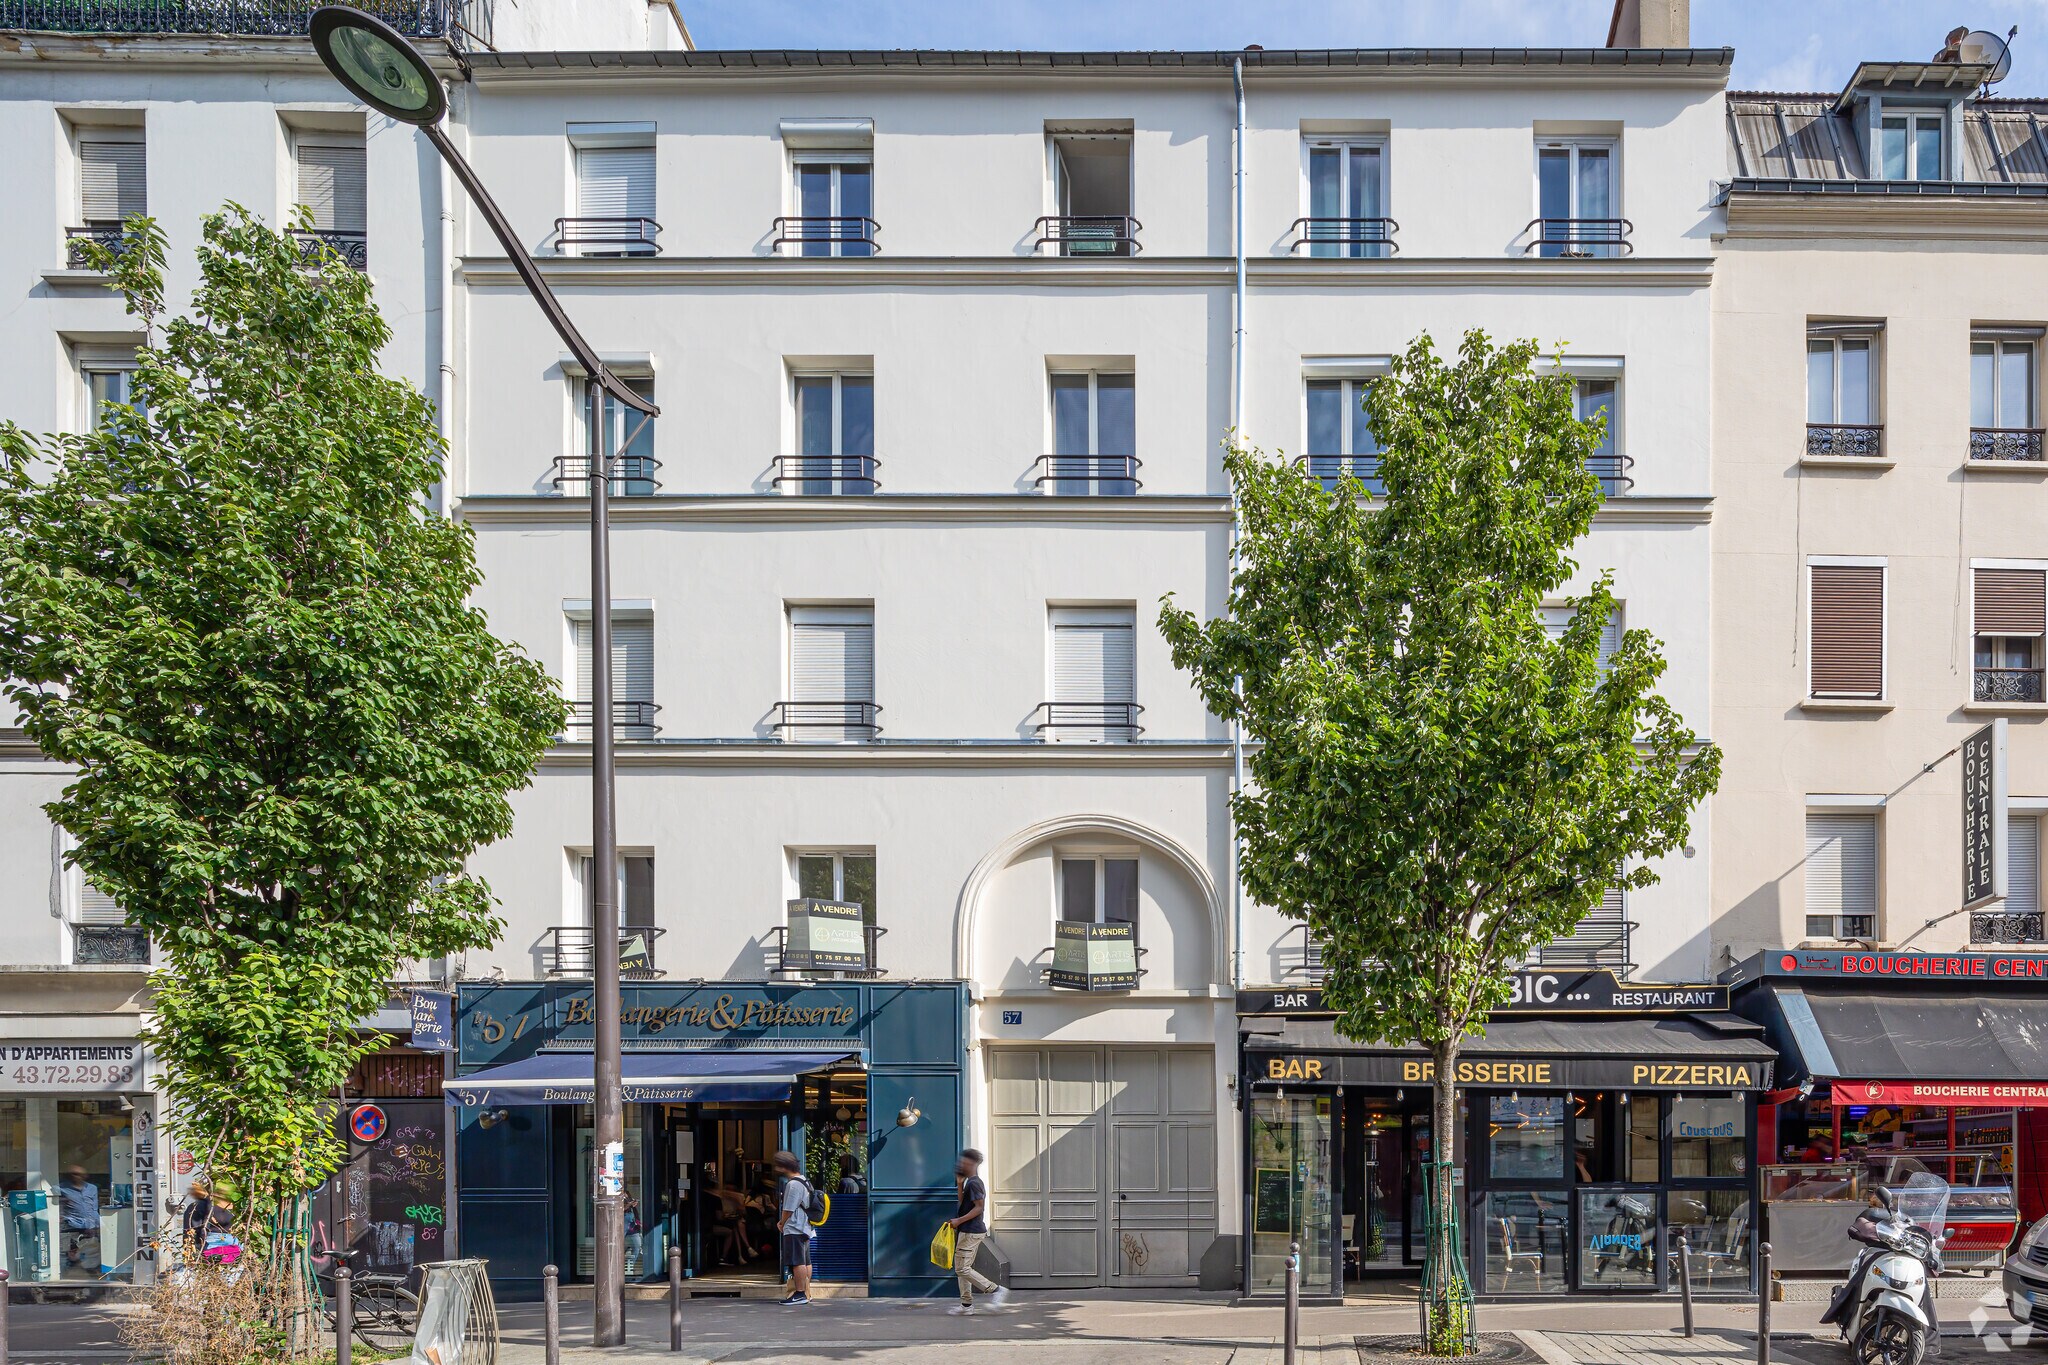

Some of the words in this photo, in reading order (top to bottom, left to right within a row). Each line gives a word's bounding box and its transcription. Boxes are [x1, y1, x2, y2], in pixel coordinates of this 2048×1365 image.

[1966, 740, 1975, 900] BOUCHERIE
[1979, 740, 1989, 886] CENTRALE
[813, 903, 820, 912] À
[822, 905, 858, 916] VENDRE
[831, 929, 859, 938] ARTIS
[1063, 926, 1086, 936] VENDRE
[1098, 928, 1129, 937] VENDRE
[1841, 955, 1986, 976] BOUCHERIE
[413, 994, 438, 1010] Bou
[1274, 994, 1308, 1007] BAR
[1612, 992, 1715, 1006] RESTAURANT
[1004, 1011, 1020, 1024] 57
[413, 1021, 442, 1036] gerie
[12, 1046, 133, 1061] D'APPARTEMENTS
[12, 1065, 134, 1084] 43.72.29.83
[1269, 1059, 1322, 1079] BAR
[1633, 1065, 1751, 1085] PIZZERIA
[634, 1087, 694, 1099] Pâtisserie
[1913, 1085, 1990, 1098] BOUCHERIE
[1993, 1086, 2048, 1099] CENTRA
[136, 1143, 153, 1260] ENTRETIEN
